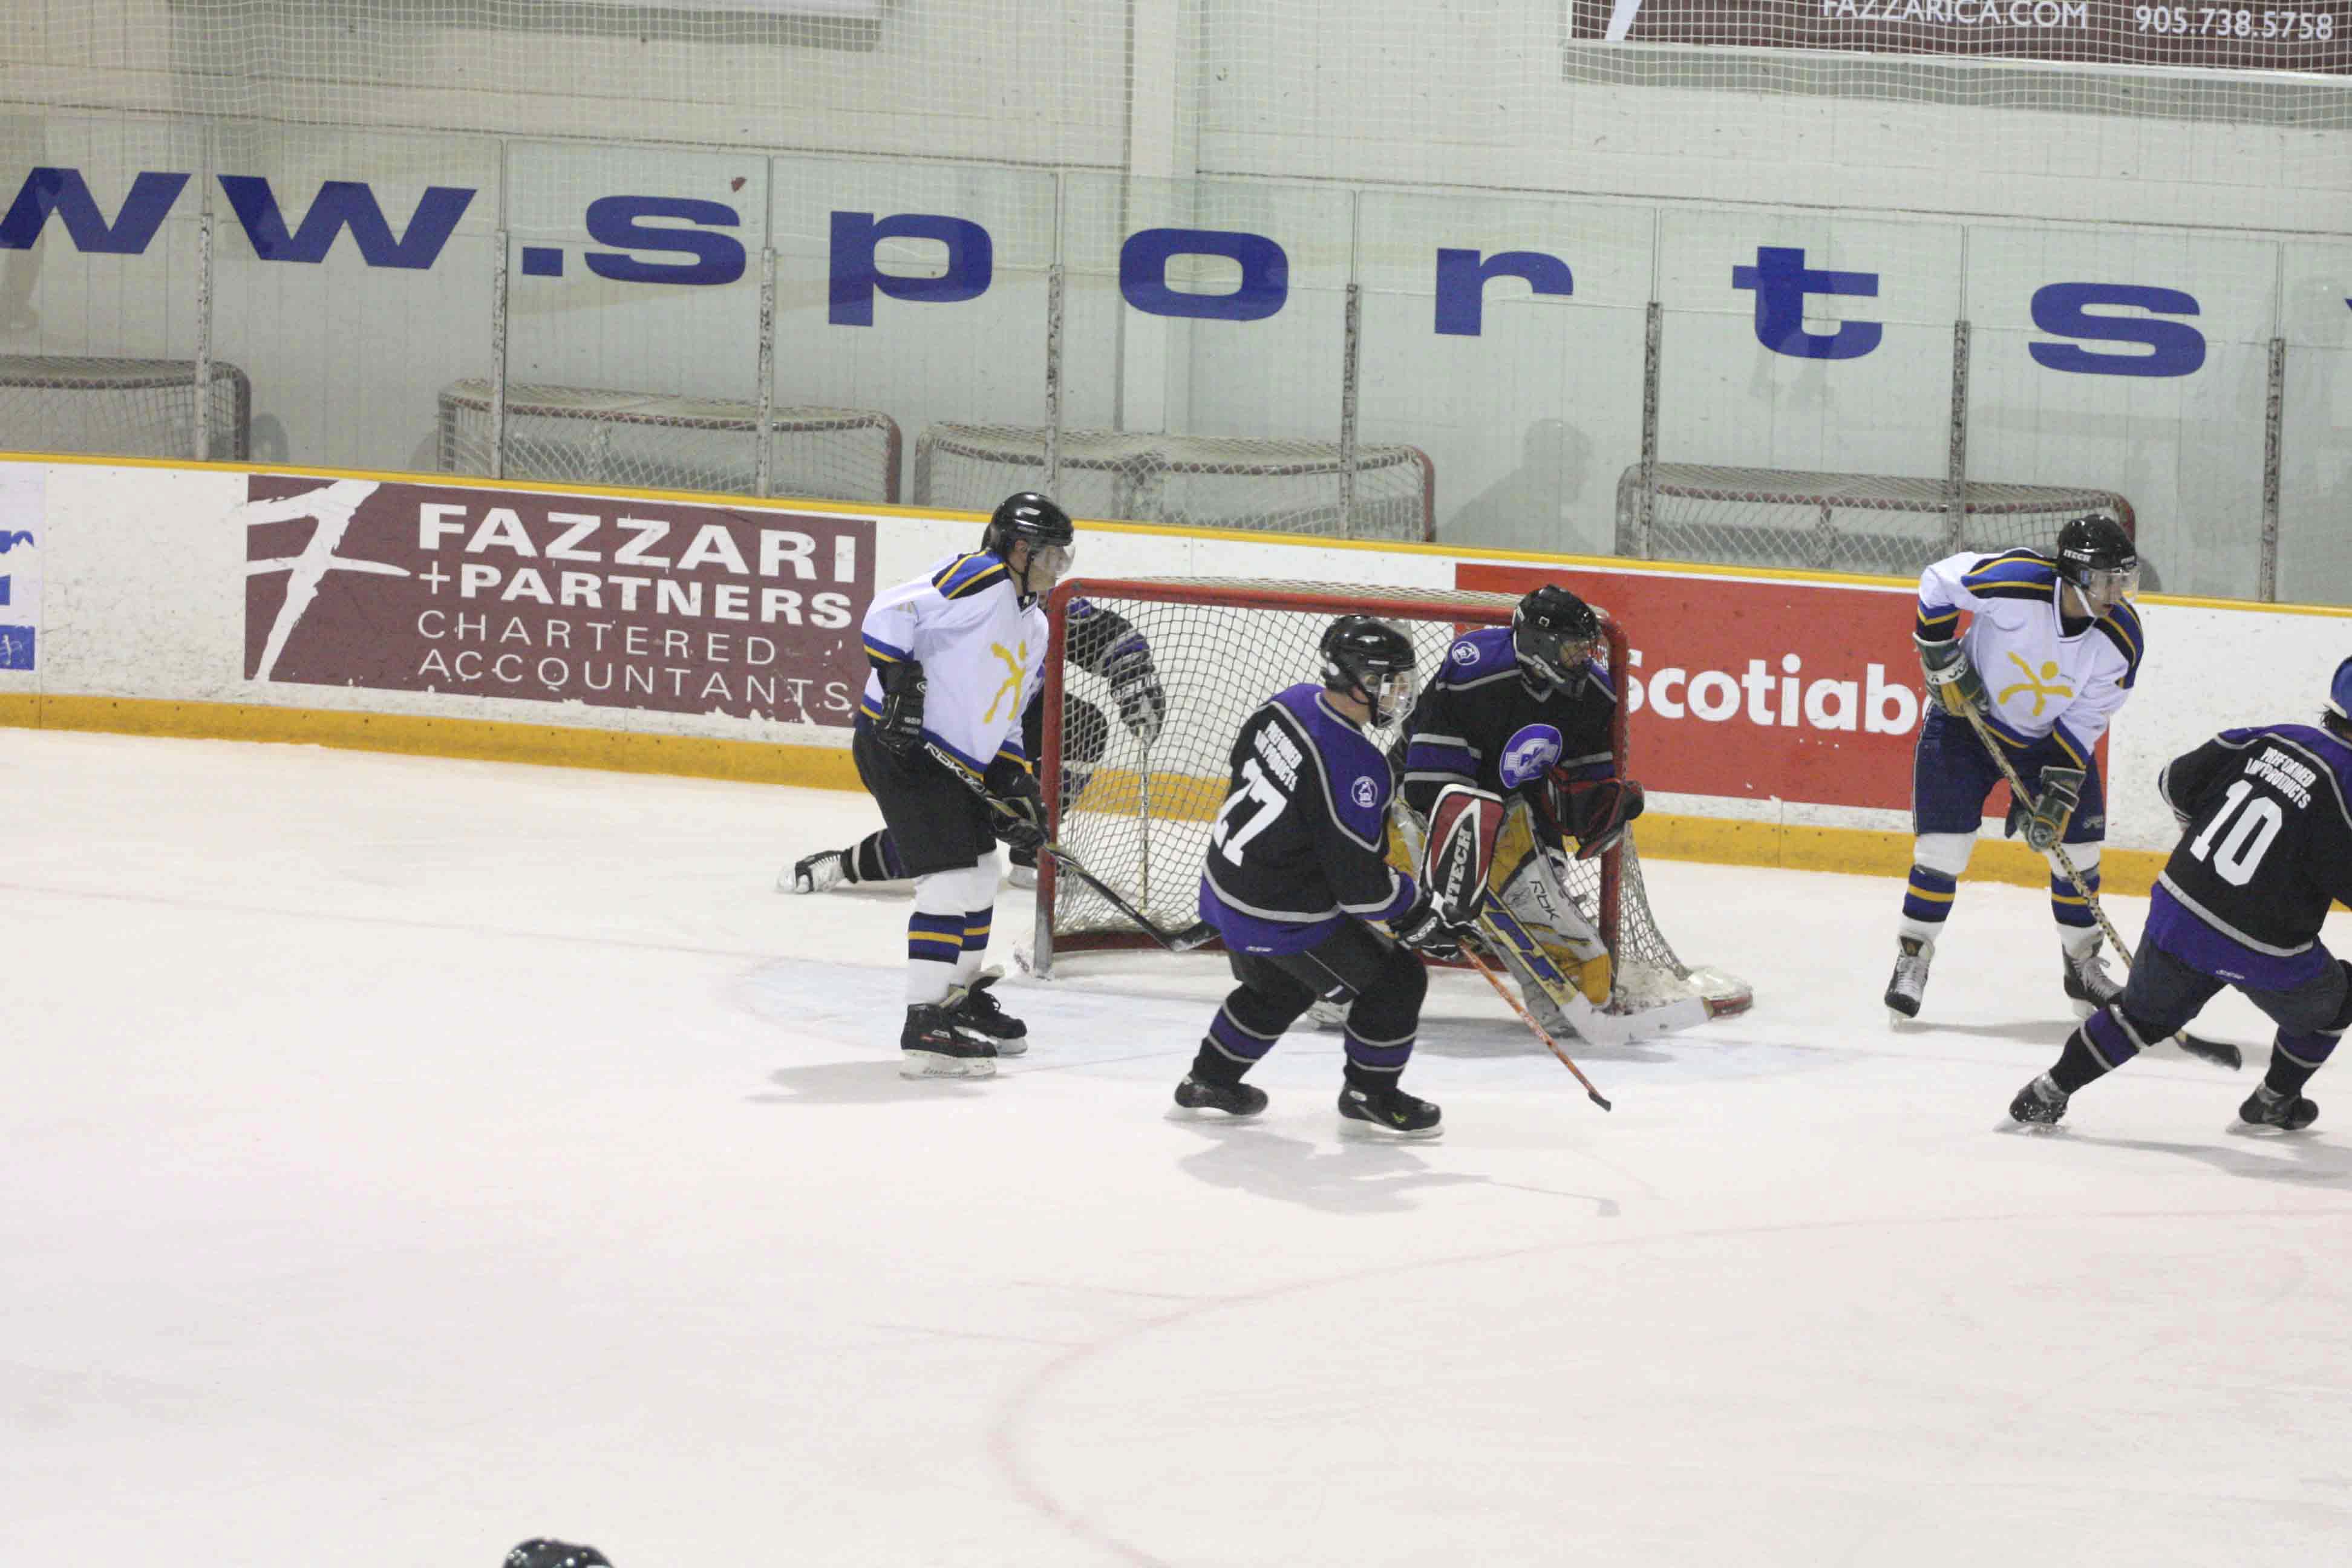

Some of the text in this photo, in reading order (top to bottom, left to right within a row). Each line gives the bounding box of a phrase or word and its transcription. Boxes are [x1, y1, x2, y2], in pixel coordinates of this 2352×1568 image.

[2135, 5, 2333, 40] 905.738.5758
[419, 503, 856, 583] FAZZARI
[418, 610, 775, 665] CHARTERED
[418, 648, 852, 711] ACCOUNTANTS
[1627, 647, 1931, 736] Scotiab
[2189, 779, 2283, 886] 10
